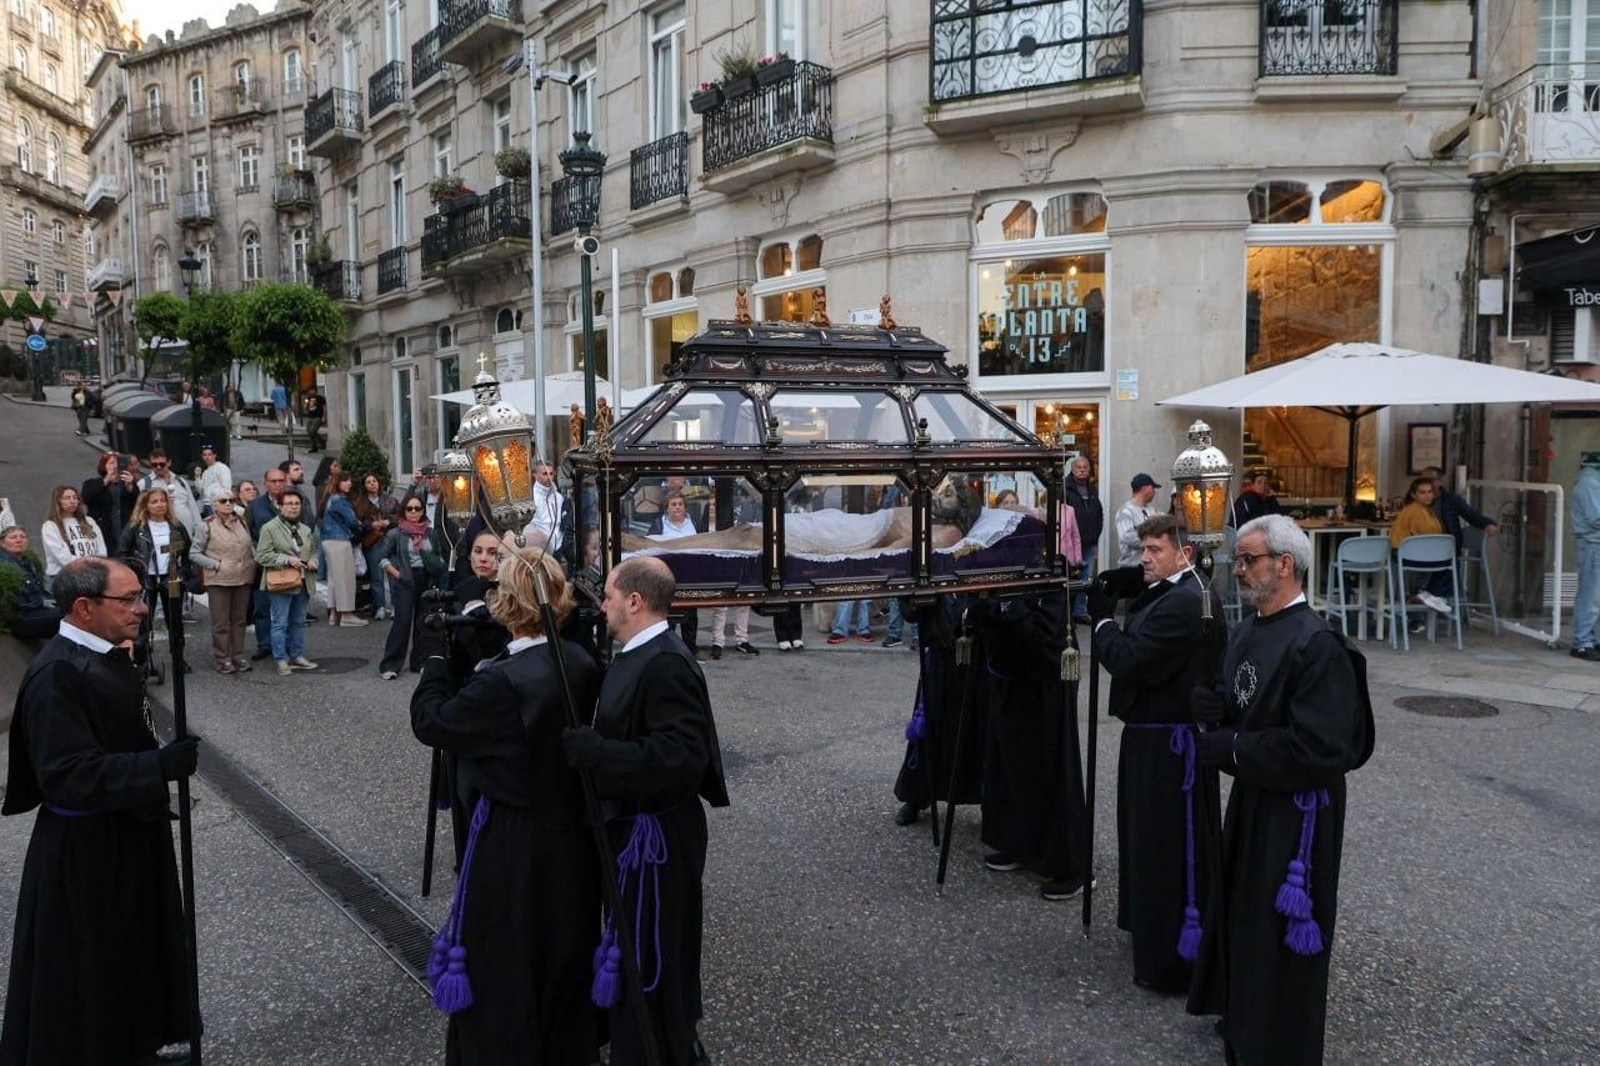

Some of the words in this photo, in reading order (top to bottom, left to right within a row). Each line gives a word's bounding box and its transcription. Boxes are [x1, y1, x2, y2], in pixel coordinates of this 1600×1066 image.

[1033, 270, 1046, 280] LA
[1002, 280, 1080, 309] ENTRE
[1564, 287, 1600, 306] Tabe
[994, 307, 1086, 340] PLANTA
[1029, 337, 1051, 363] 13
